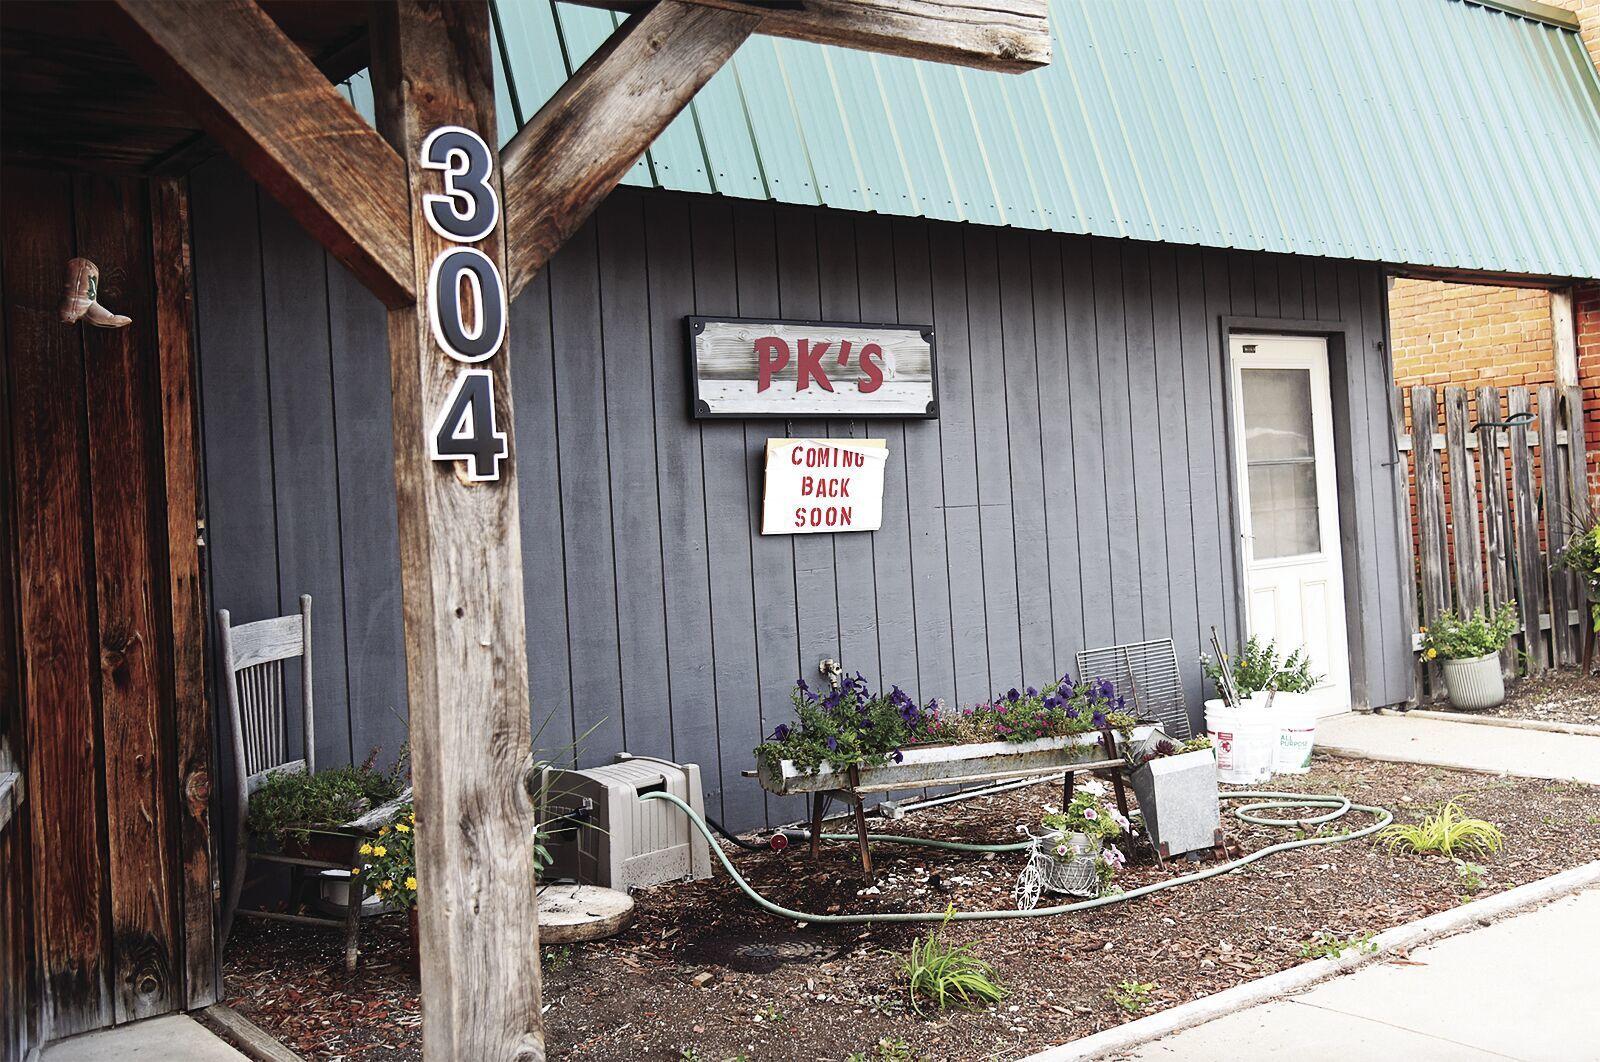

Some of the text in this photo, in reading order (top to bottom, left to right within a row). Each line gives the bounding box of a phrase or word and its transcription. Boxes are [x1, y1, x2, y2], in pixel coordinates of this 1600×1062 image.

[422, 126, 508, 481] 304
[754, 336, 884, 394] PK'S
[791, 445, 865, 468] COMING
[801, 476, 850, 498] BACK
[795, 506, 852, 527] SOON
